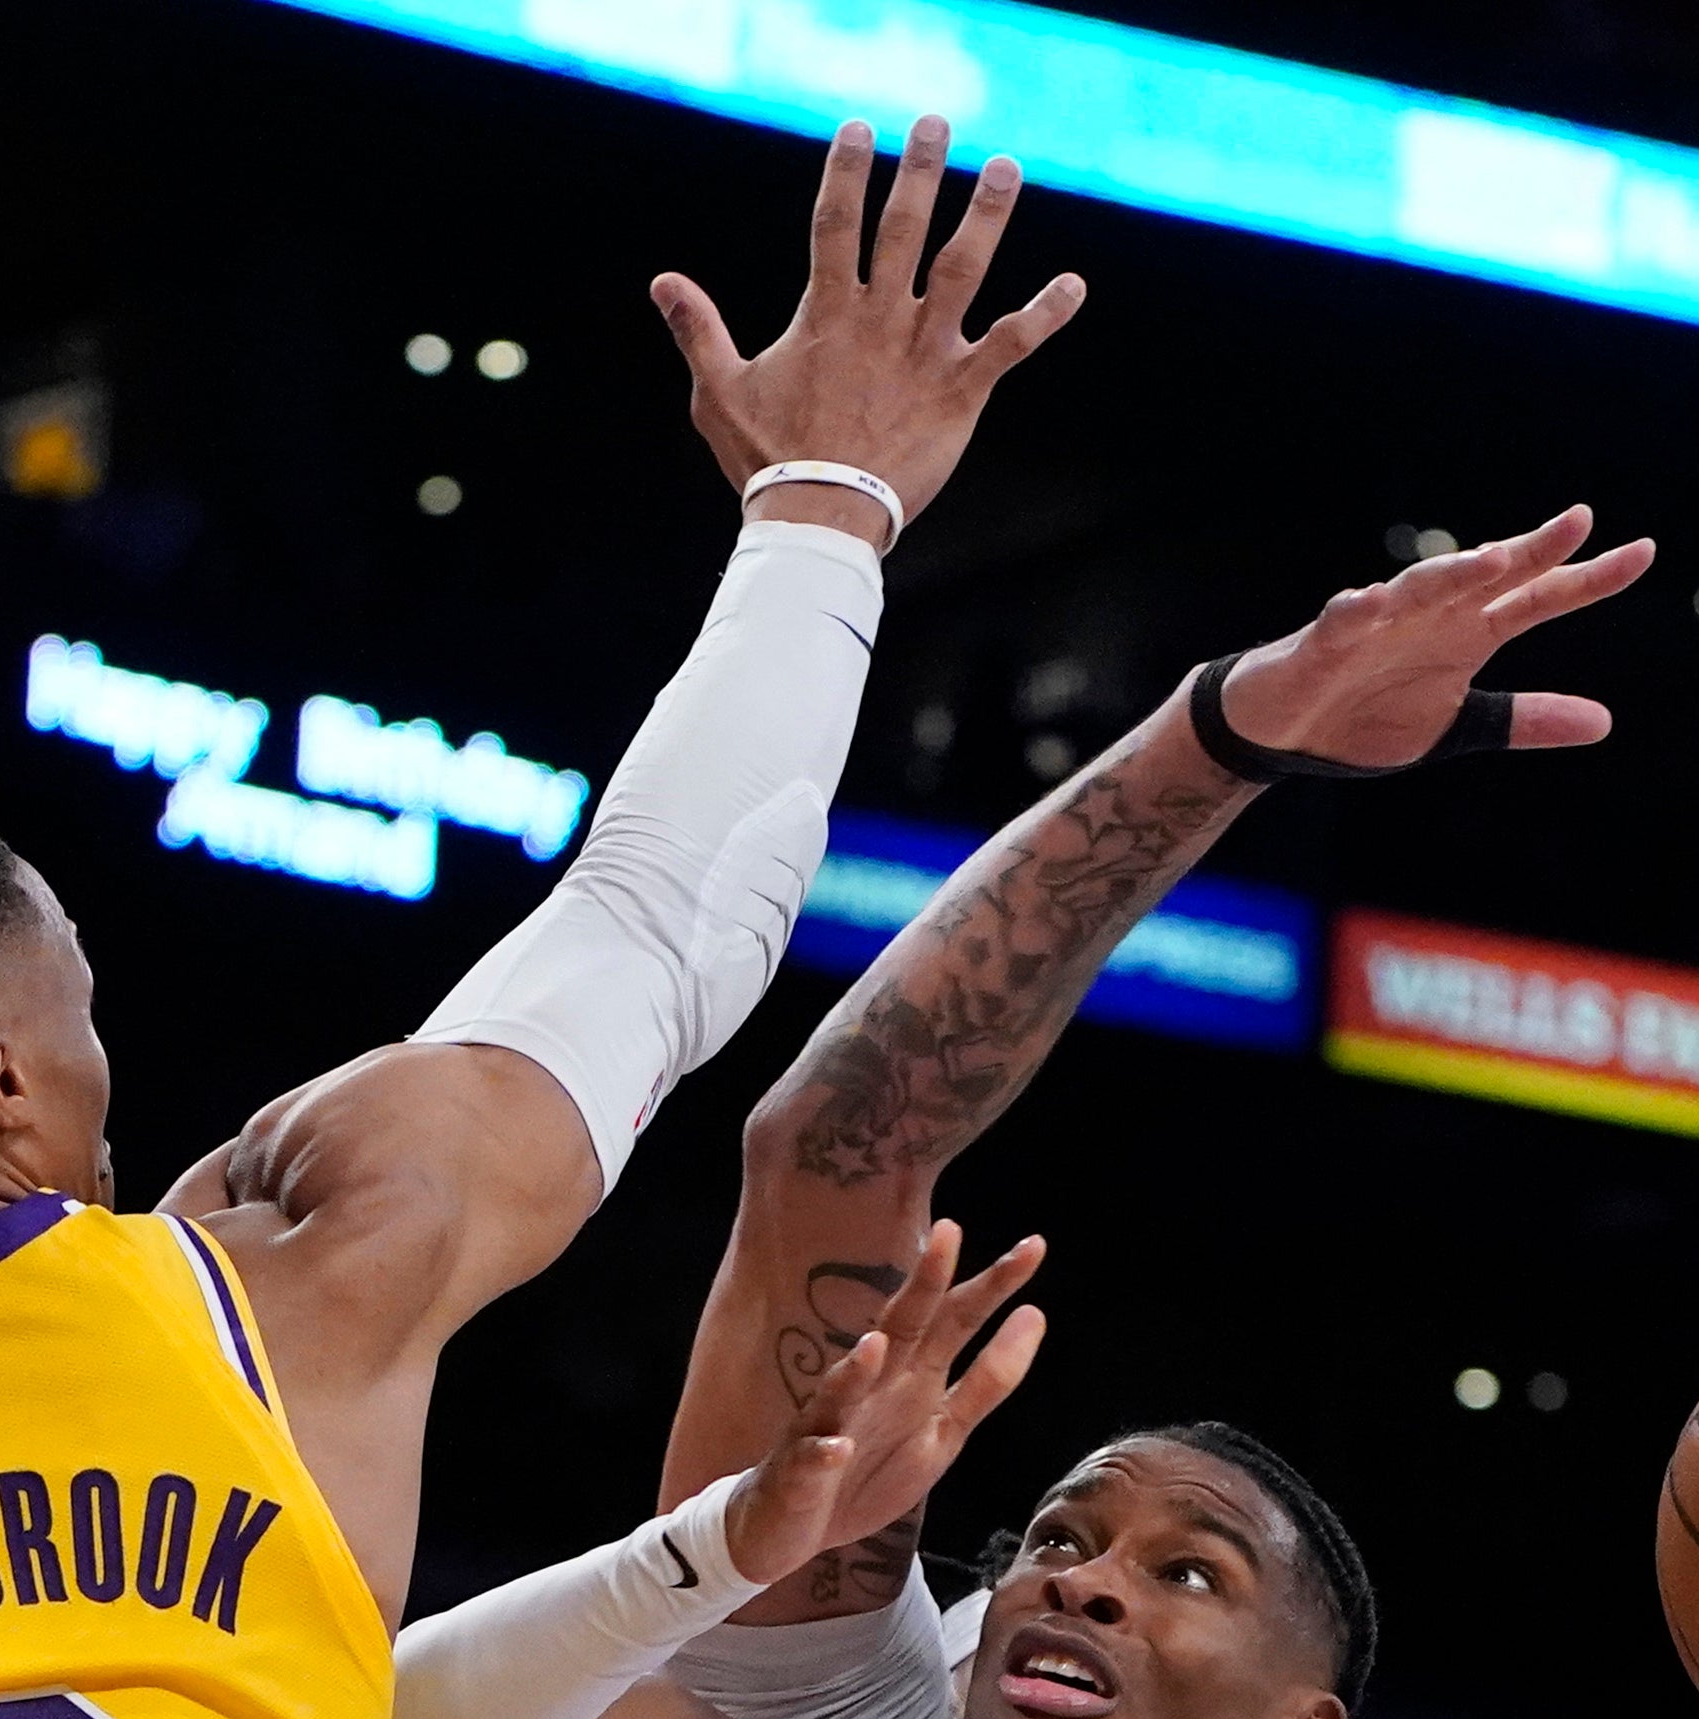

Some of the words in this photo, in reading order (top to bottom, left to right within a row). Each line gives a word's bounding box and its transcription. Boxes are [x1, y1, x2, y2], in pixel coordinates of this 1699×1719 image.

[26, 634, 268, 781] Happy
[297, 694, 588, 861] Birthday
[1369, 944, 1615, 1066] WELLS
